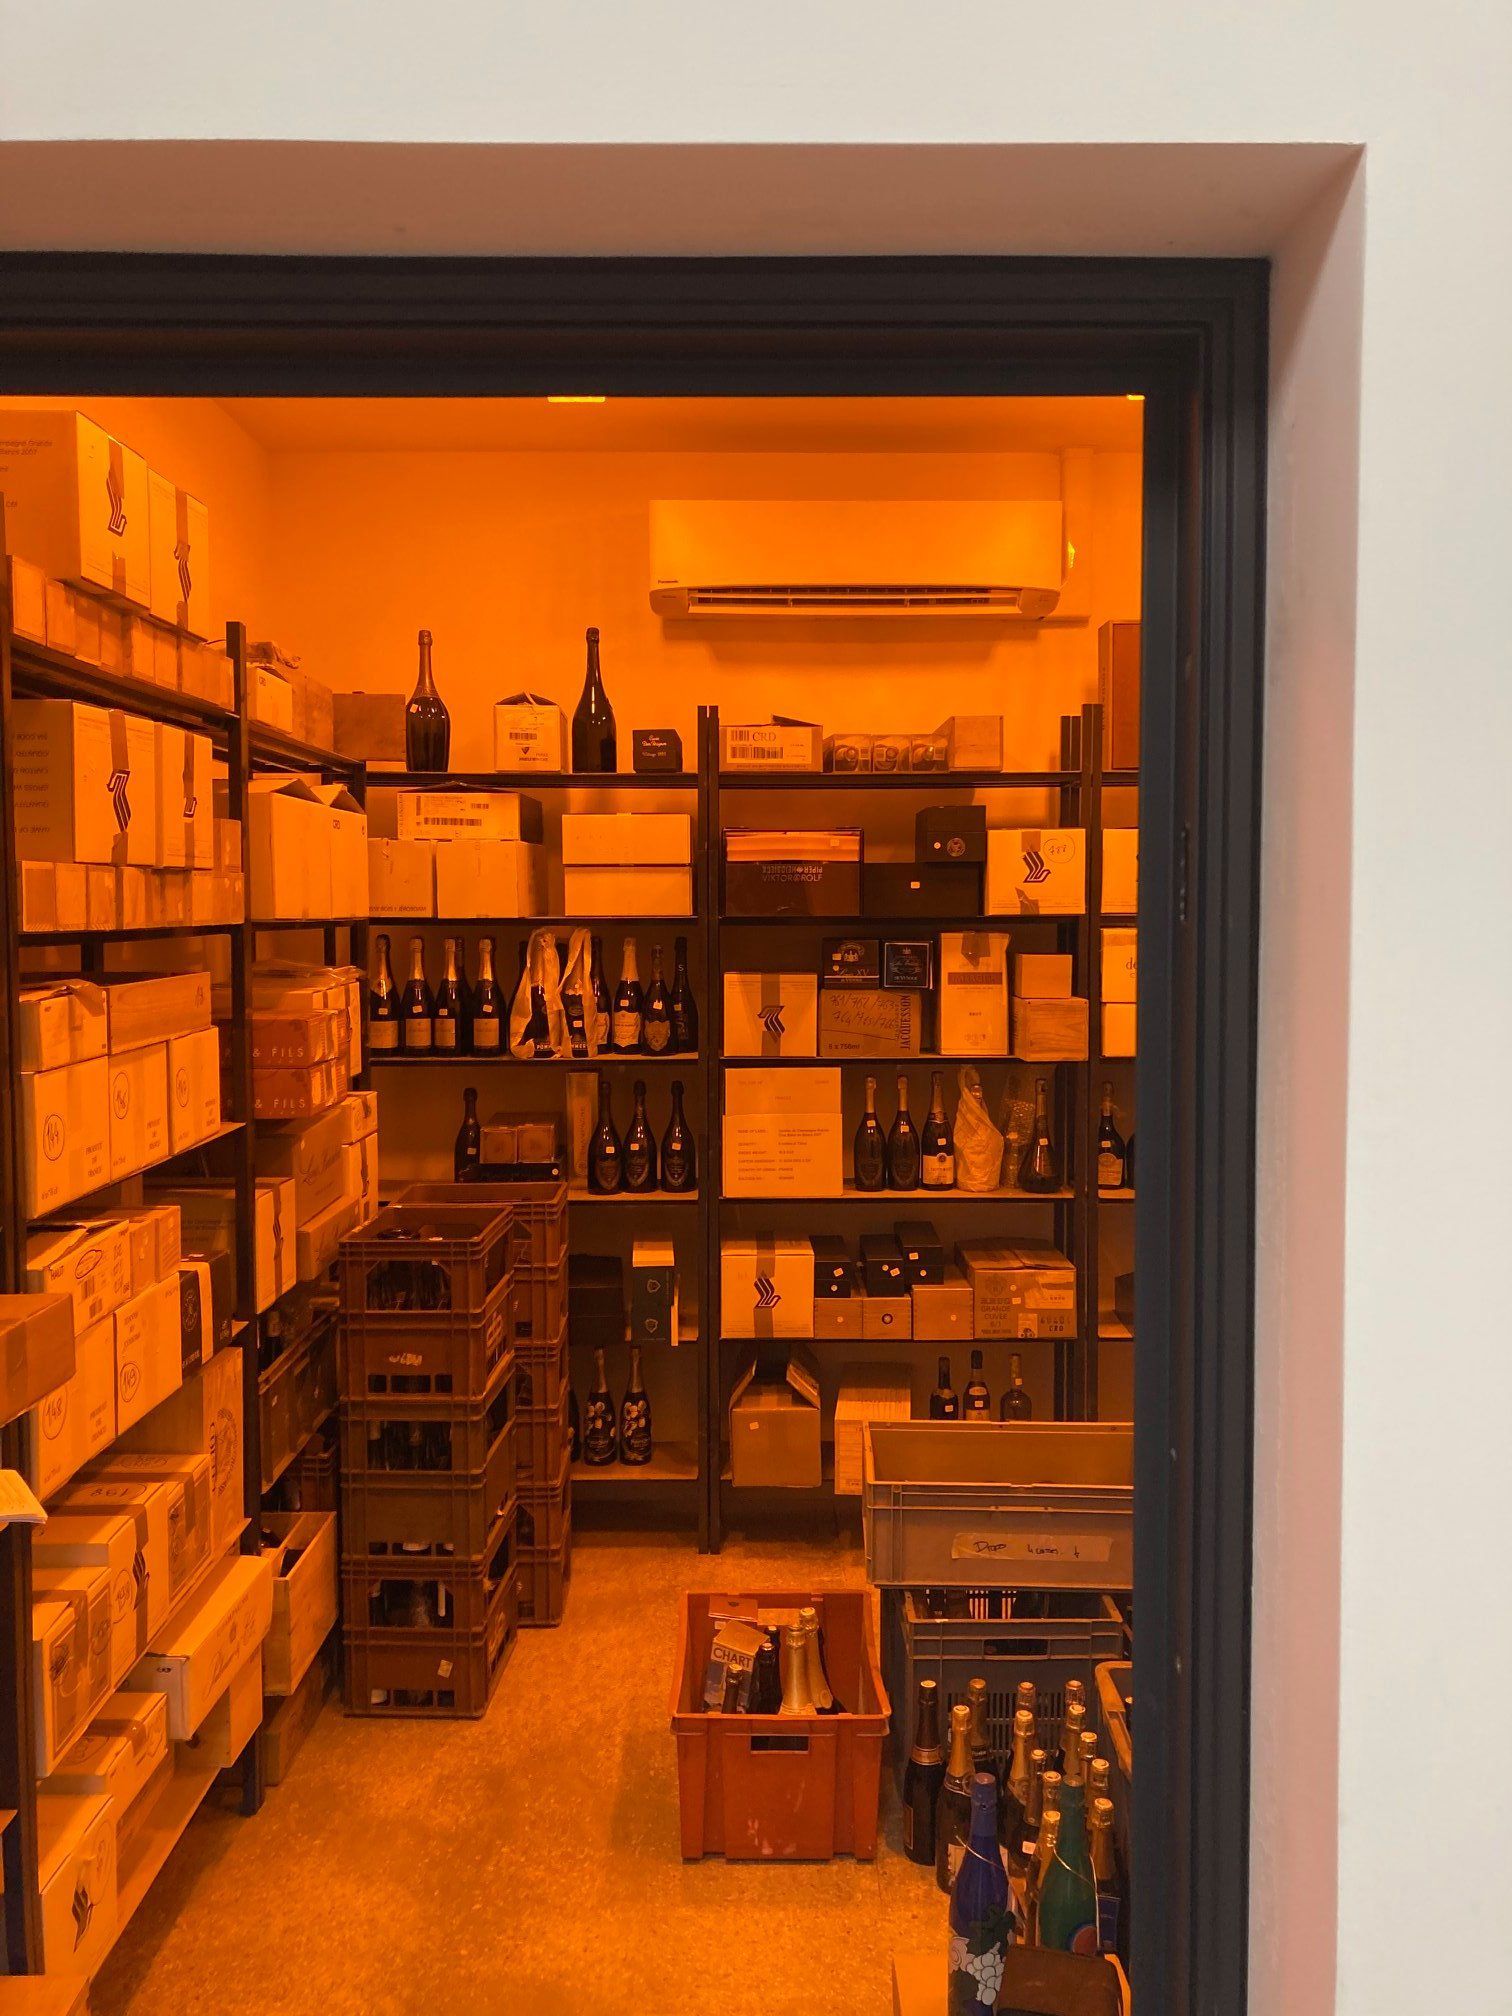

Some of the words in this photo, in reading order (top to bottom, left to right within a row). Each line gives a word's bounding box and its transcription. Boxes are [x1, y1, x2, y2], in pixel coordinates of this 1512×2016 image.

[752, 731, 777, 742] CRD
[803, 865, 823, 874] PIPER
[899, 994, 911, 1050] JACQUESSON
[252, 1049, 262, 1058] &
[271, 1047, 305, 1058] FILS
[254, 1099, 263, 1108] &
[273, 1098, 306, 1108] FILS
[981, 1305, 1011, 1313] GRANDE
[712, 1645, 753, 1668] CHART
